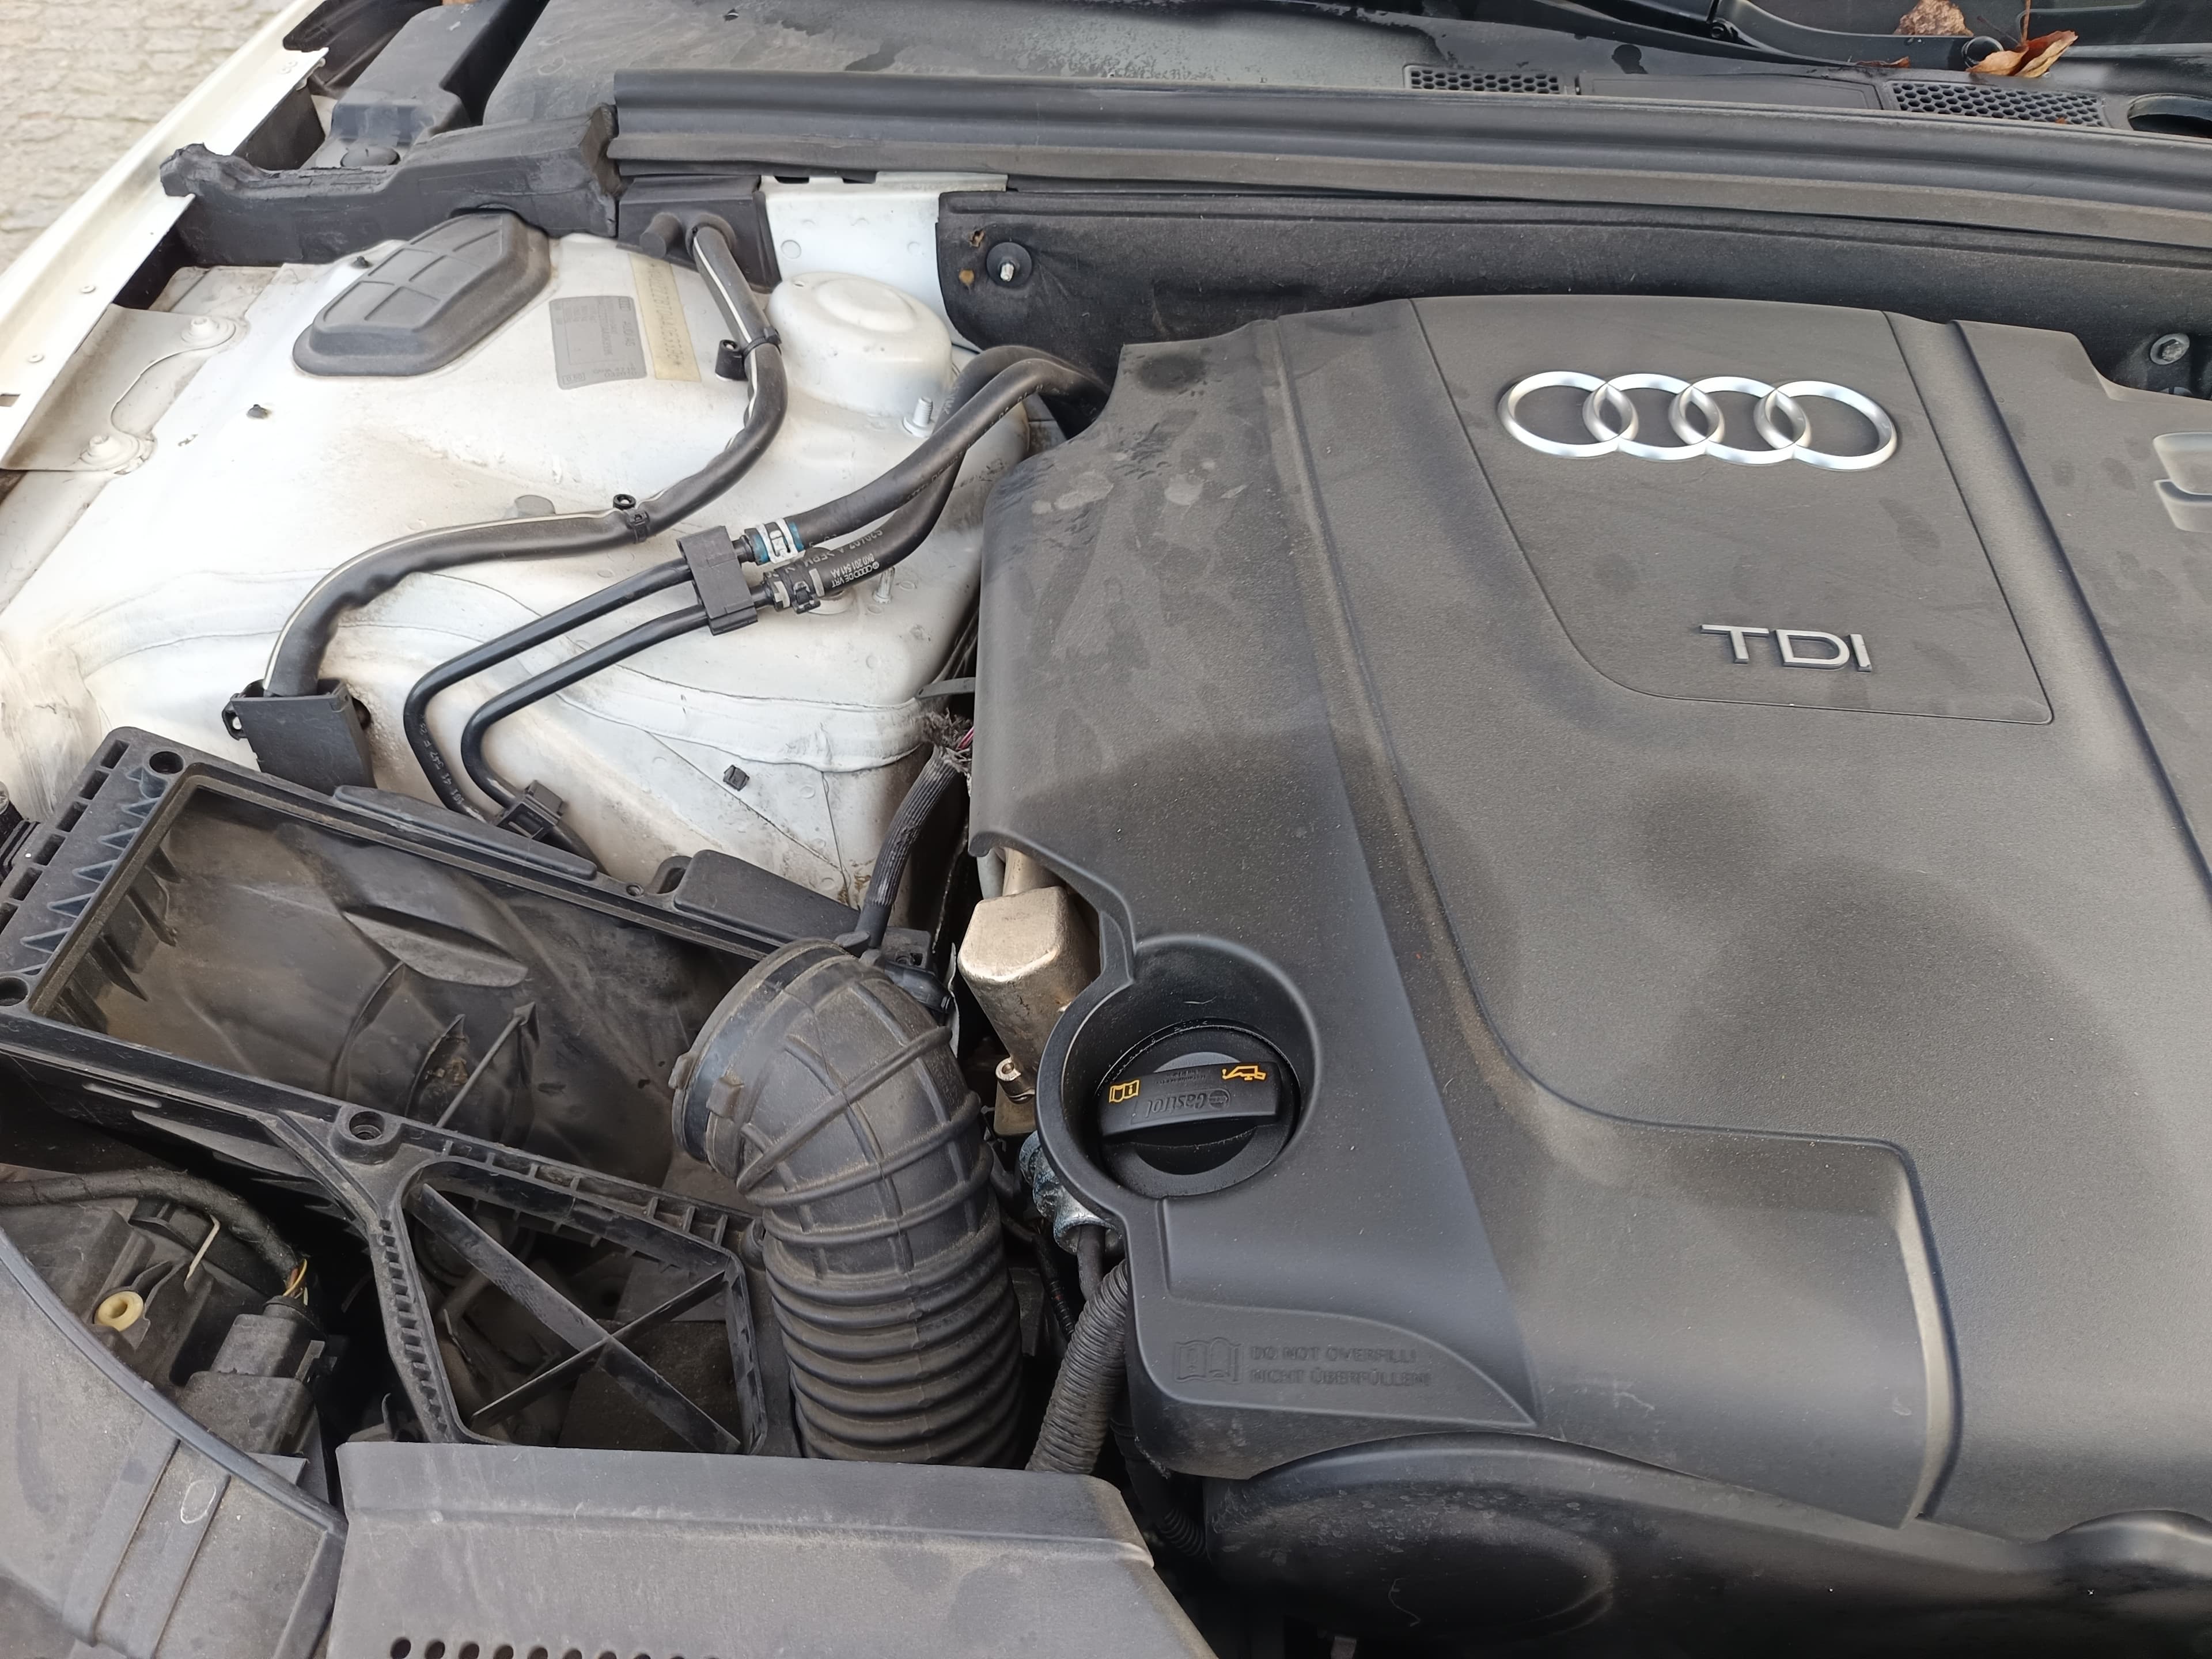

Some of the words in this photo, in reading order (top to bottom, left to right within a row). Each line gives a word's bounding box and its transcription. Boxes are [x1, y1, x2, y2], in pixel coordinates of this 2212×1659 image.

[1700, 624, 1872, 672] TDI
[1145, 1092, 1207, 1118] Castrol
[1250, 1347, 1278, 1361] DO
[1282, 1347, 1320, 1362] NOT
[1249, 1370, 1305, 1385] NICHT
